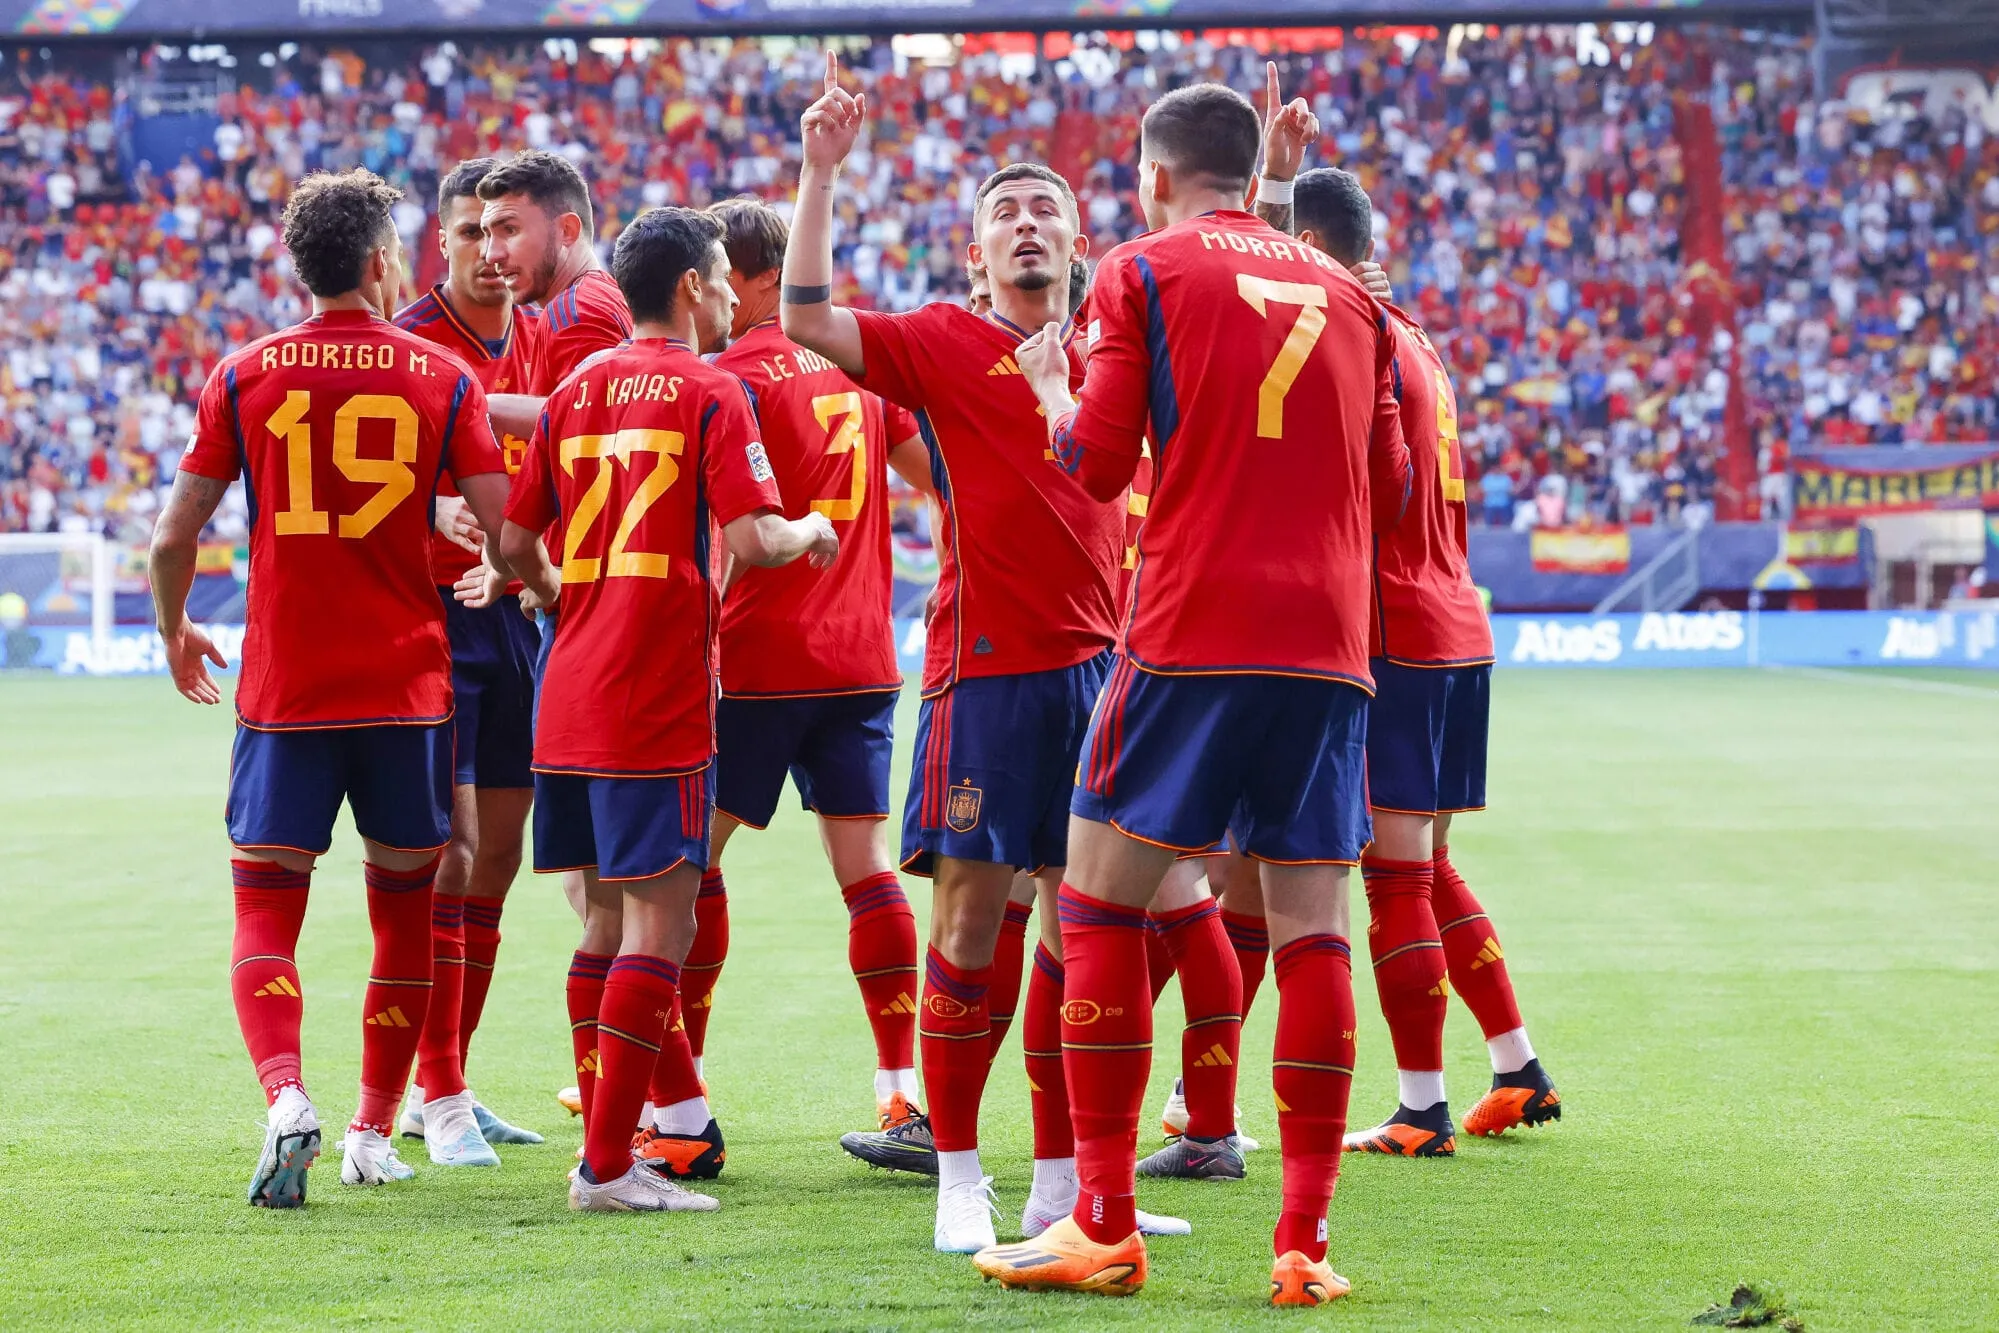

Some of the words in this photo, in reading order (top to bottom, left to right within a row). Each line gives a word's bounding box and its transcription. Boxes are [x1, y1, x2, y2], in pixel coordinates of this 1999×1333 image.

[1198, 230, 1333, 270] MORATA
[262, 343, 394, 370] RODRIGO
[408, 350, 436, 377] M.
[573, 381, 592, 409] J.
[606, 374, 683, 407] NAVAS
[761, 354, 795, 381] LE
[1236, 273, 1328, 439] 7
[265, 390, 419, 538] 19
[810, 391, 867, 520] 3
[559, 429, 685, 583] 22
